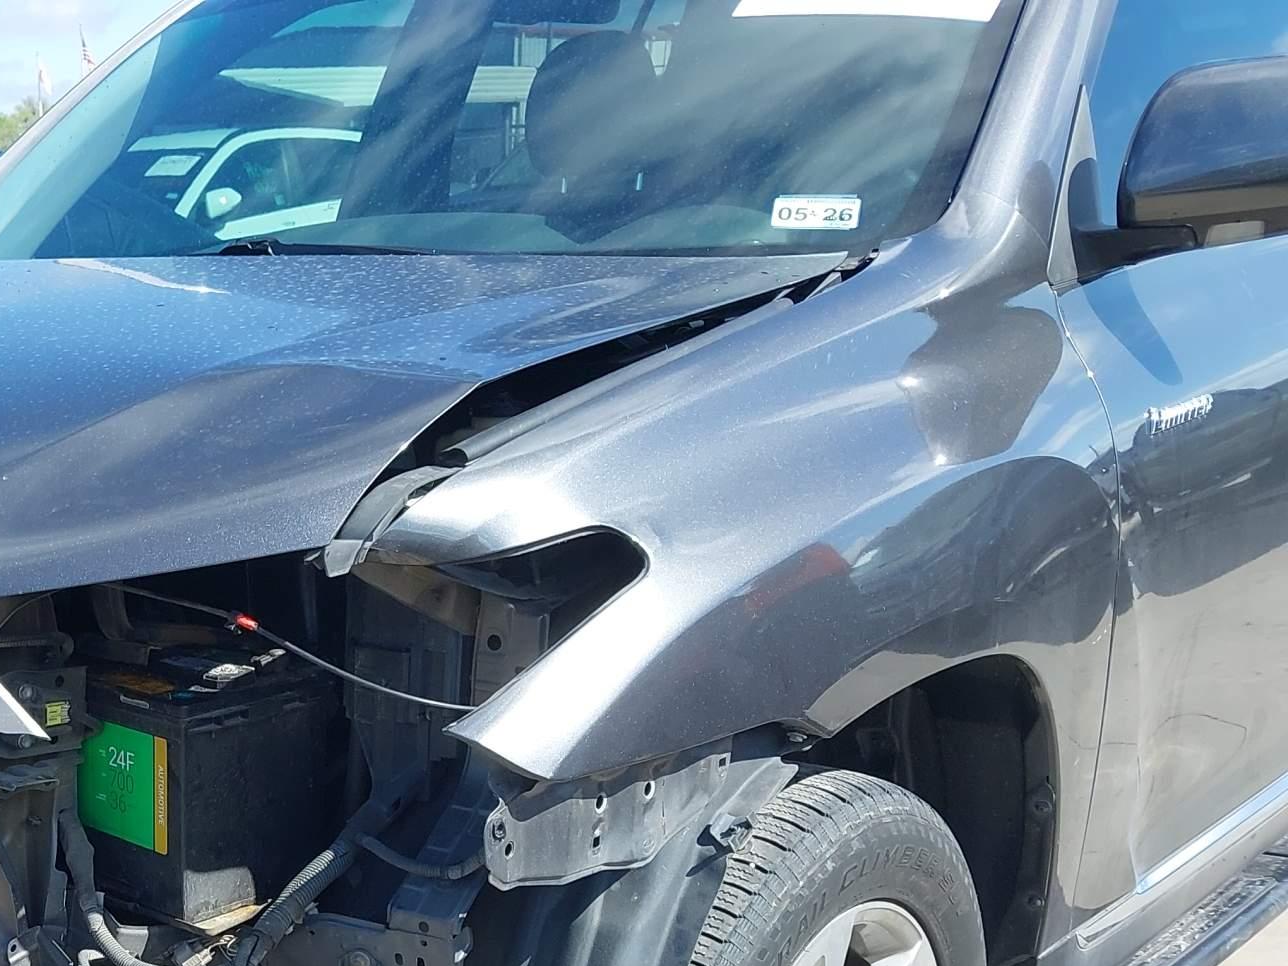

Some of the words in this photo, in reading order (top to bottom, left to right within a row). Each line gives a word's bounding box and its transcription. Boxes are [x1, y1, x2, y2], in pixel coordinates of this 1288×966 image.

[778, 207, 808, 221] 05
[823, 208, 854, 221] 26
[108, 746, 135, 771] 24F
[157, 764, 166, 826] AUTOMOTIVE
